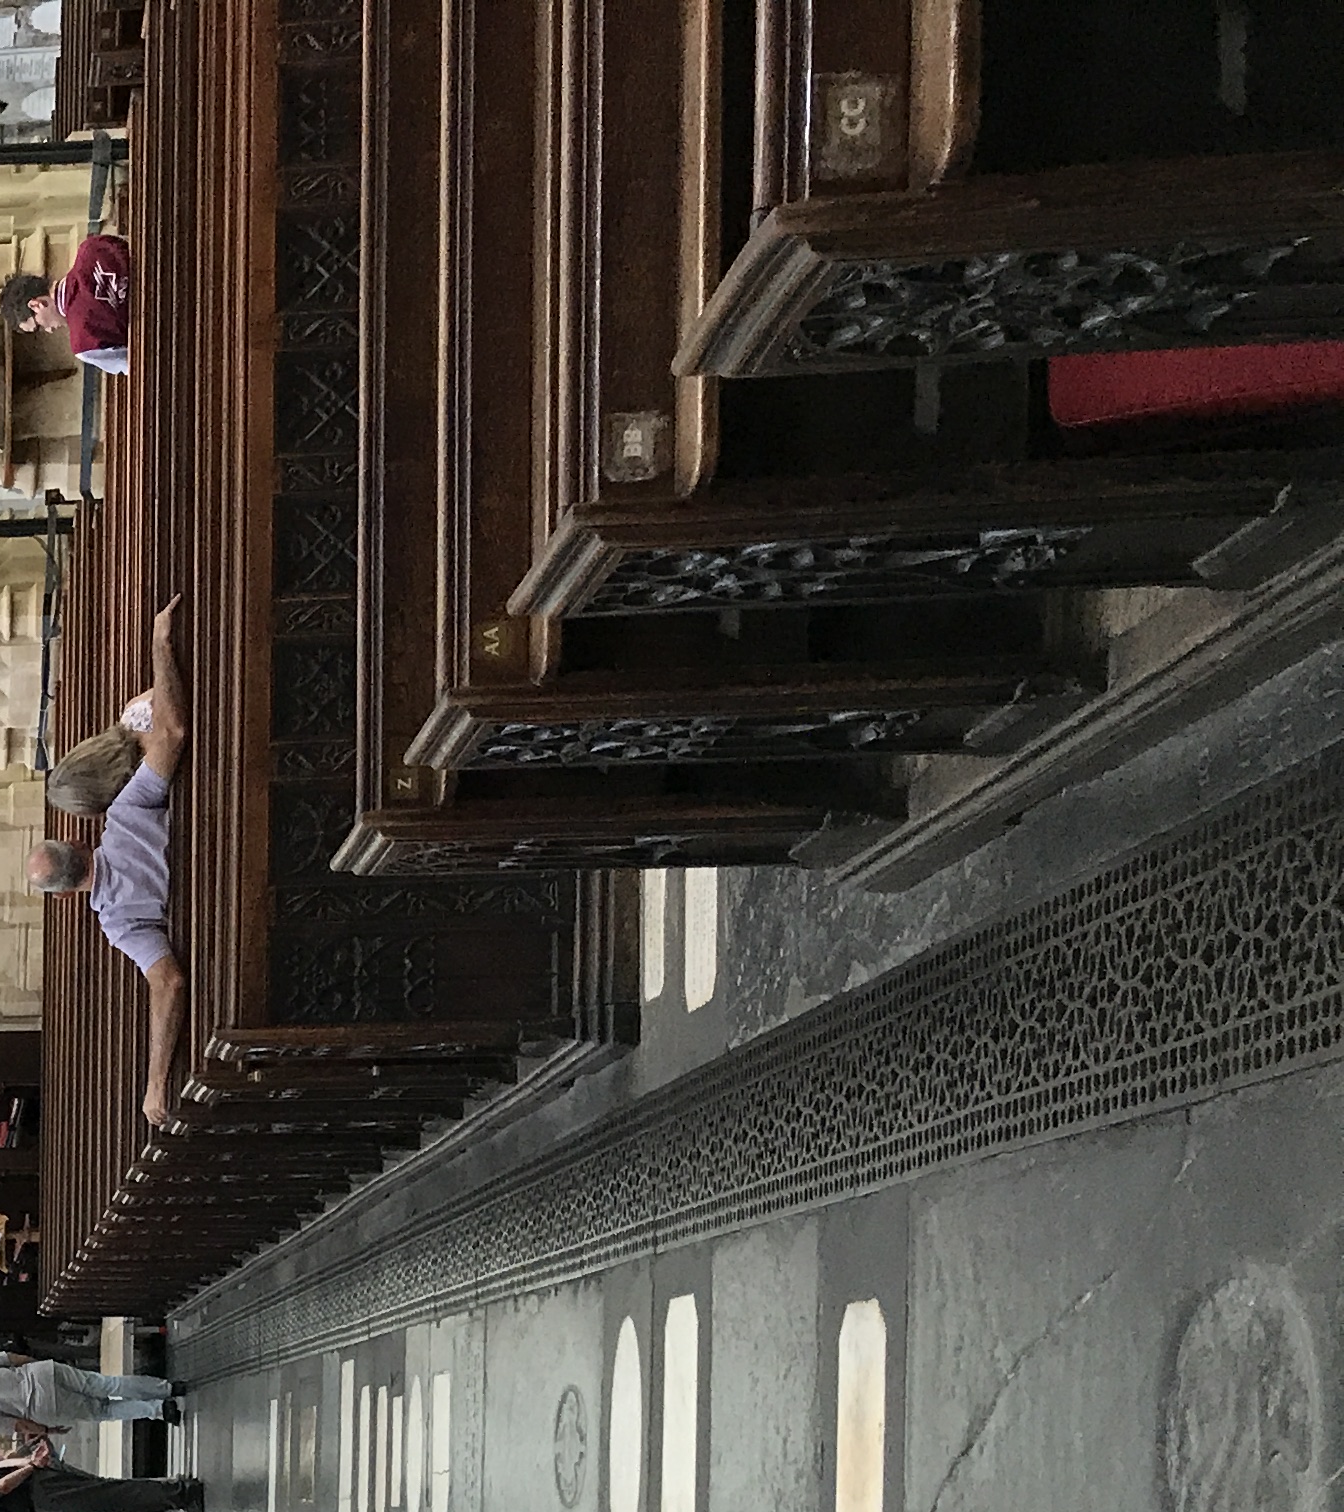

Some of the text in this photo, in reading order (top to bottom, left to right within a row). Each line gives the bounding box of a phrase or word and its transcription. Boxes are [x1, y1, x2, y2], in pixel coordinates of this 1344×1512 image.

[840, 96, 866, 136] CC
[624, 428, 644, 458] BB
[483, 626, 500, 656] AA
[398, 778, 411, 789] Z
